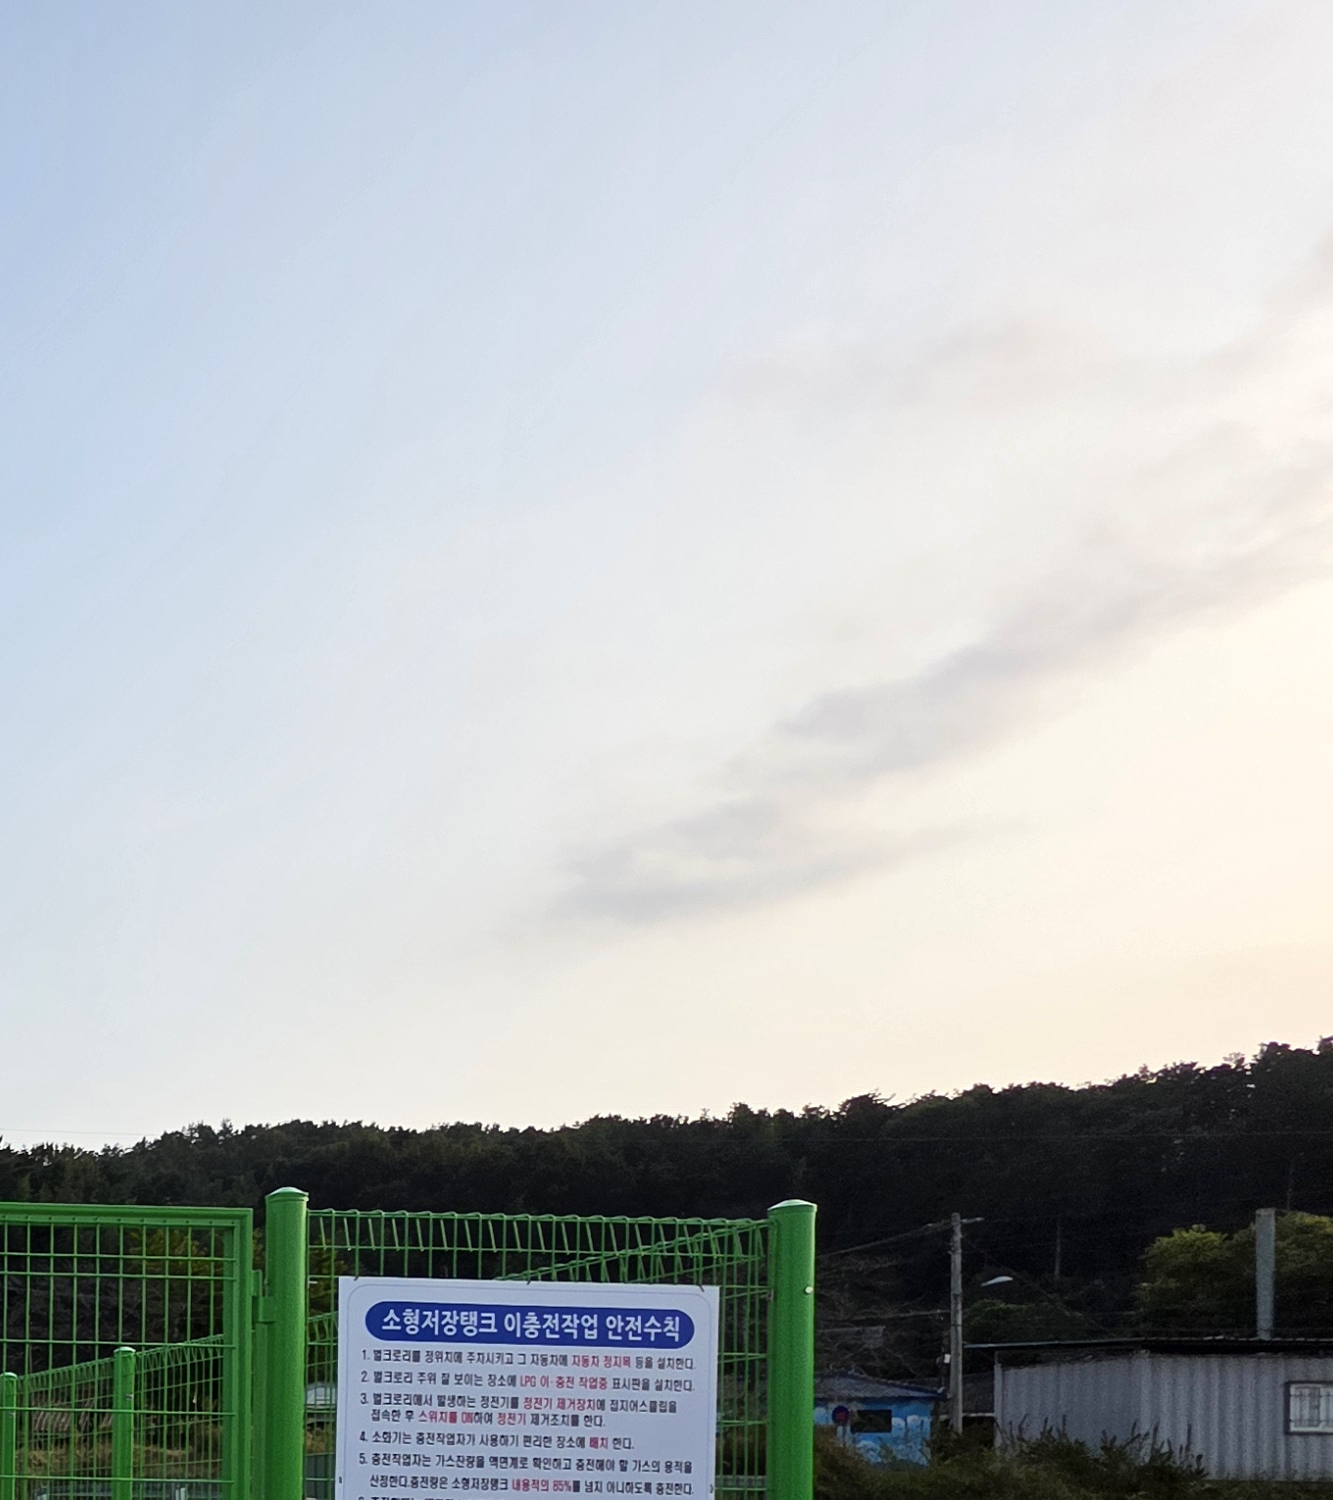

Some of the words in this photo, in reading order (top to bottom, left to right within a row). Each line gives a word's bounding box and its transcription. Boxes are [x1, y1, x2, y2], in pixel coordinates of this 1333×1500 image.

[381, 1307, 498, 1335] 소형저장탱크
[503, 1310, 598, 1340] 이충전작업
[604, 1315, 680, 1343] 안전수칙
[372, 1348, 421, 1365] 벌크로리를
[424, 1349, 463, 1364] 정위치에
[465, 1351, 514, 1365] 주차시키고
[516, 1352, 527, 1365] 그
[529, 1352, 568, 1367] 자동차에
[570, 1354, 600, 1368] 자동차
[602, 1355, 631, 1369] 정지목
[634, 1355, 653, 1370] 등을
[656, 1356, 696, 1371] 설치한다.
[372, 1369, 413, 1387] 벌크로리
[416, 1371, 437, 1385] 주위
[453, 1372, 483, 1387] 보이는
[486, 1373, 517, 1388] 장소에
[578, 1375, 608, 1390] 작업중
[610, 1376, 650, 1391] 표시판을
[653, 1378, 695, 1392] 설치한다.
[372, 1391, 433, 1409] 벌크로리에서
[436, 1394, 477, 1409] 발생하는
[478, 1395, 520, 1410] 정전기를
[522, 1396, 553, 1411] 정전기
[555, 1397, 606, 1412] 제거장치에
[370, 1407, 402, 1423] 접속한
[404, 1409, 415, 1423] 후
[417, 1409, 458, 1424] 스위치를
[496, 1411, 527, 1426] 정전기
[529, 1412, 579, 1427] 제거조치를
[582, 1413, 606, 1427] 한다.
[371, 1430, 412, 1445] 소화기는
[415, 1431, 476, 1446] 충전작업자가
[478, 1433, 519, 1448] 사용하기
[522, 1434, 553, 1448] 편리한
[555, 1435, 586, 1449] 장소에
[611, 1436, 635, 1451] 한다.
[370, 1452, 432, 1467] 충전작업자는
[532, 1456, 572, 1471] 확인하고
[575, 1457, 616, 1472] 충전해야
[631, 1458, 660, 1473] 가스의
[663, 1459, 692, 1474] 용적을
[511, 1477, 549, 1493] 내용적의
[584, 1479, 603, 1494] 넘지
[655, 1481, 695, 1496] 충전한다.
